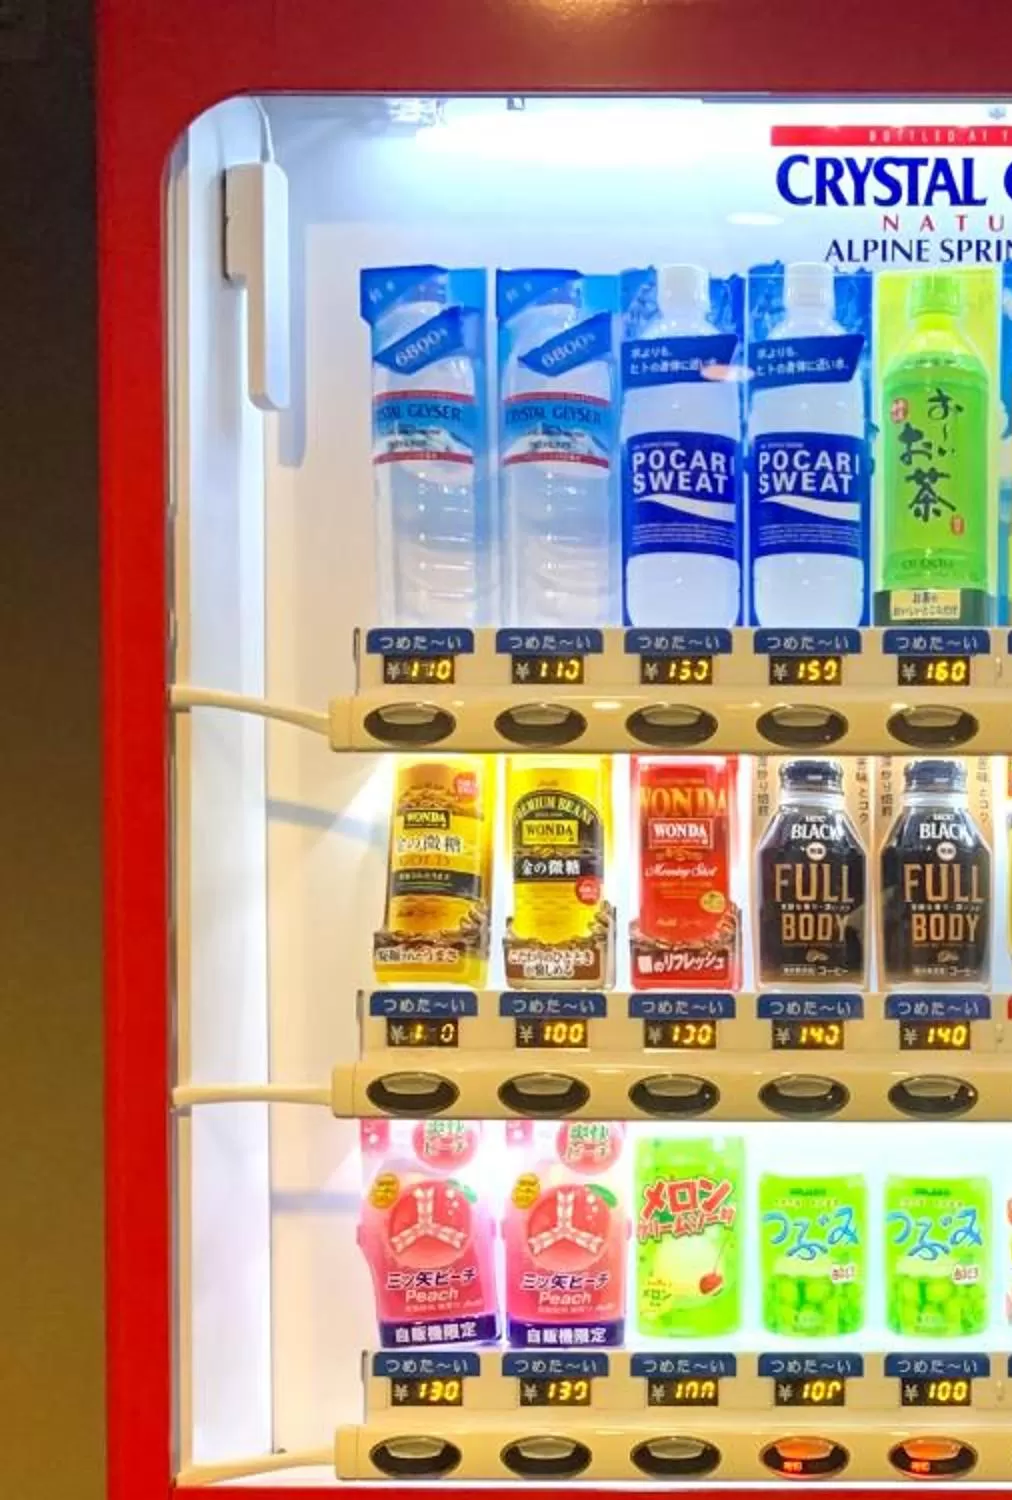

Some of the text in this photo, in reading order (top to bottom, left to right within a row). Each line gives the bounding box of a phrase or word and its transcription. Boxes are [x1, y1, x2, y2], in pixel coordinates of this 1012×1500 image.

[775, 153, 989, 208] CRYSTAL
[824, 238, 931, 263] ALPINE
[758, 450, 860, 476] POCARI
[898, 421, 958, 523] お茶
[632, 471, 729, 495] SWEAT
[758, 471, 854, 495] SWEAT
[525, 823, 574, 837] WONDA
[652, 822, 708, 838] WONDA
[774, 863, 855, 903] FULL
[903, 863, 984, 903] FULL
[780, 913, 850, 941] BODY
[911, 913, 981, 942] BODY
[642, 1177, 733, 1220] メロン
[405, 1287, 459, 1304] Peach
[538, 1291, 593, 1306] Peach
[395, 1322, 478, 1344] 自販機限定
[526, 1327, 608, 1345] 自販機限定
